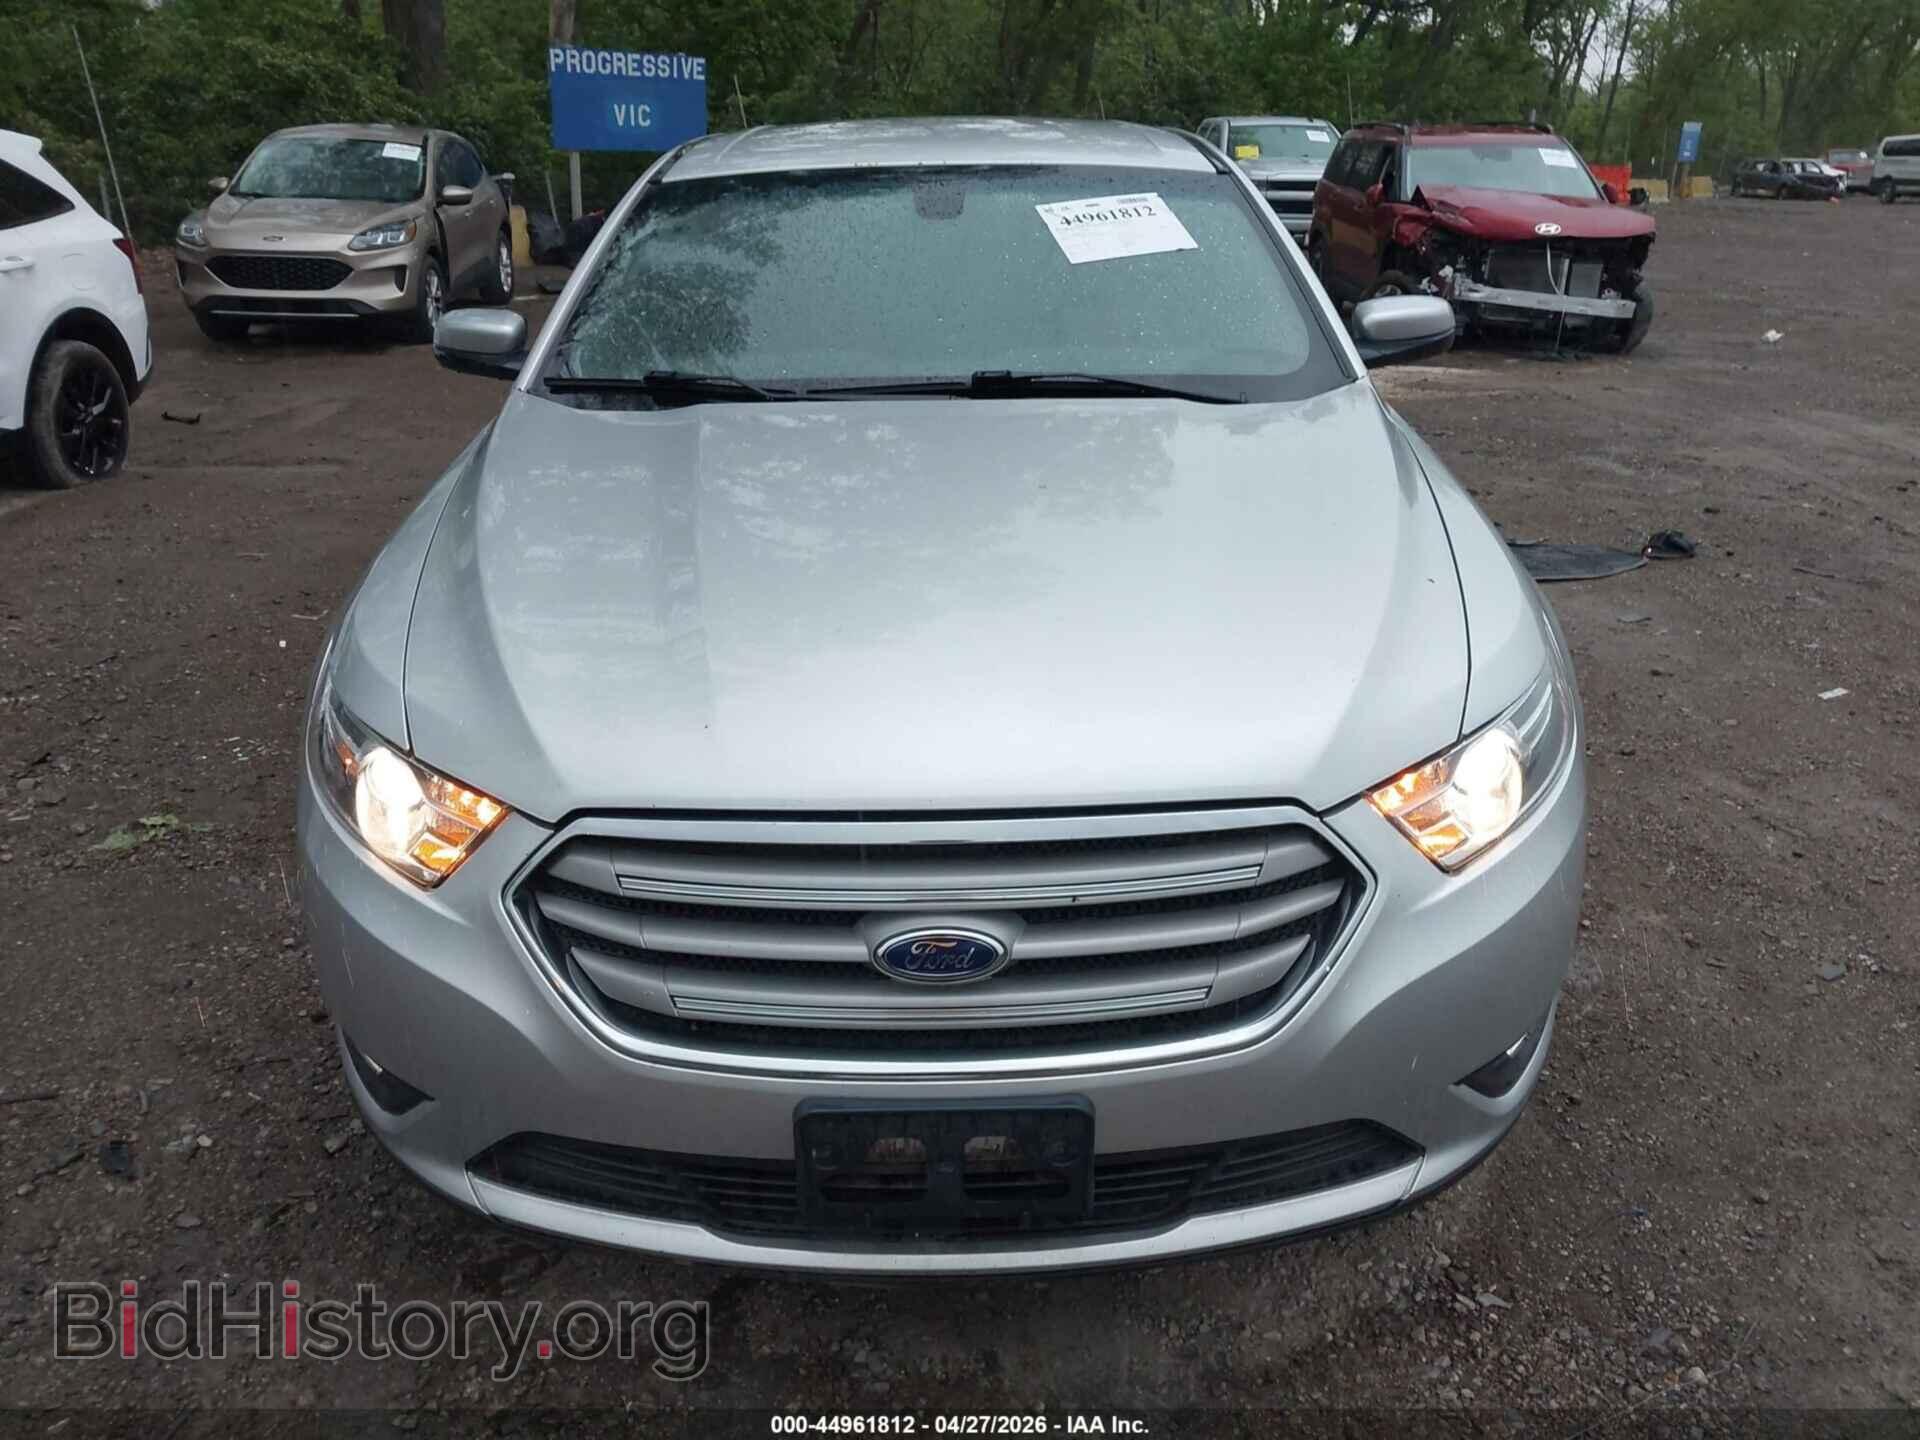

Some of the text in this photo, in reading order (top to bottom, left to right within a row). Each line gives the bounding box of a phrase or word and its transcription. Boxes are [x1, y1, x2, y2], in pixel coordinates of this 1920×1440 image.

[549, 48, 706, 80] PROGRESSIVE
[613, 103, 651, 127] VIC
[1060, 205, 1157, 227] 44961812
[905, 941, 975, 969] Ford
